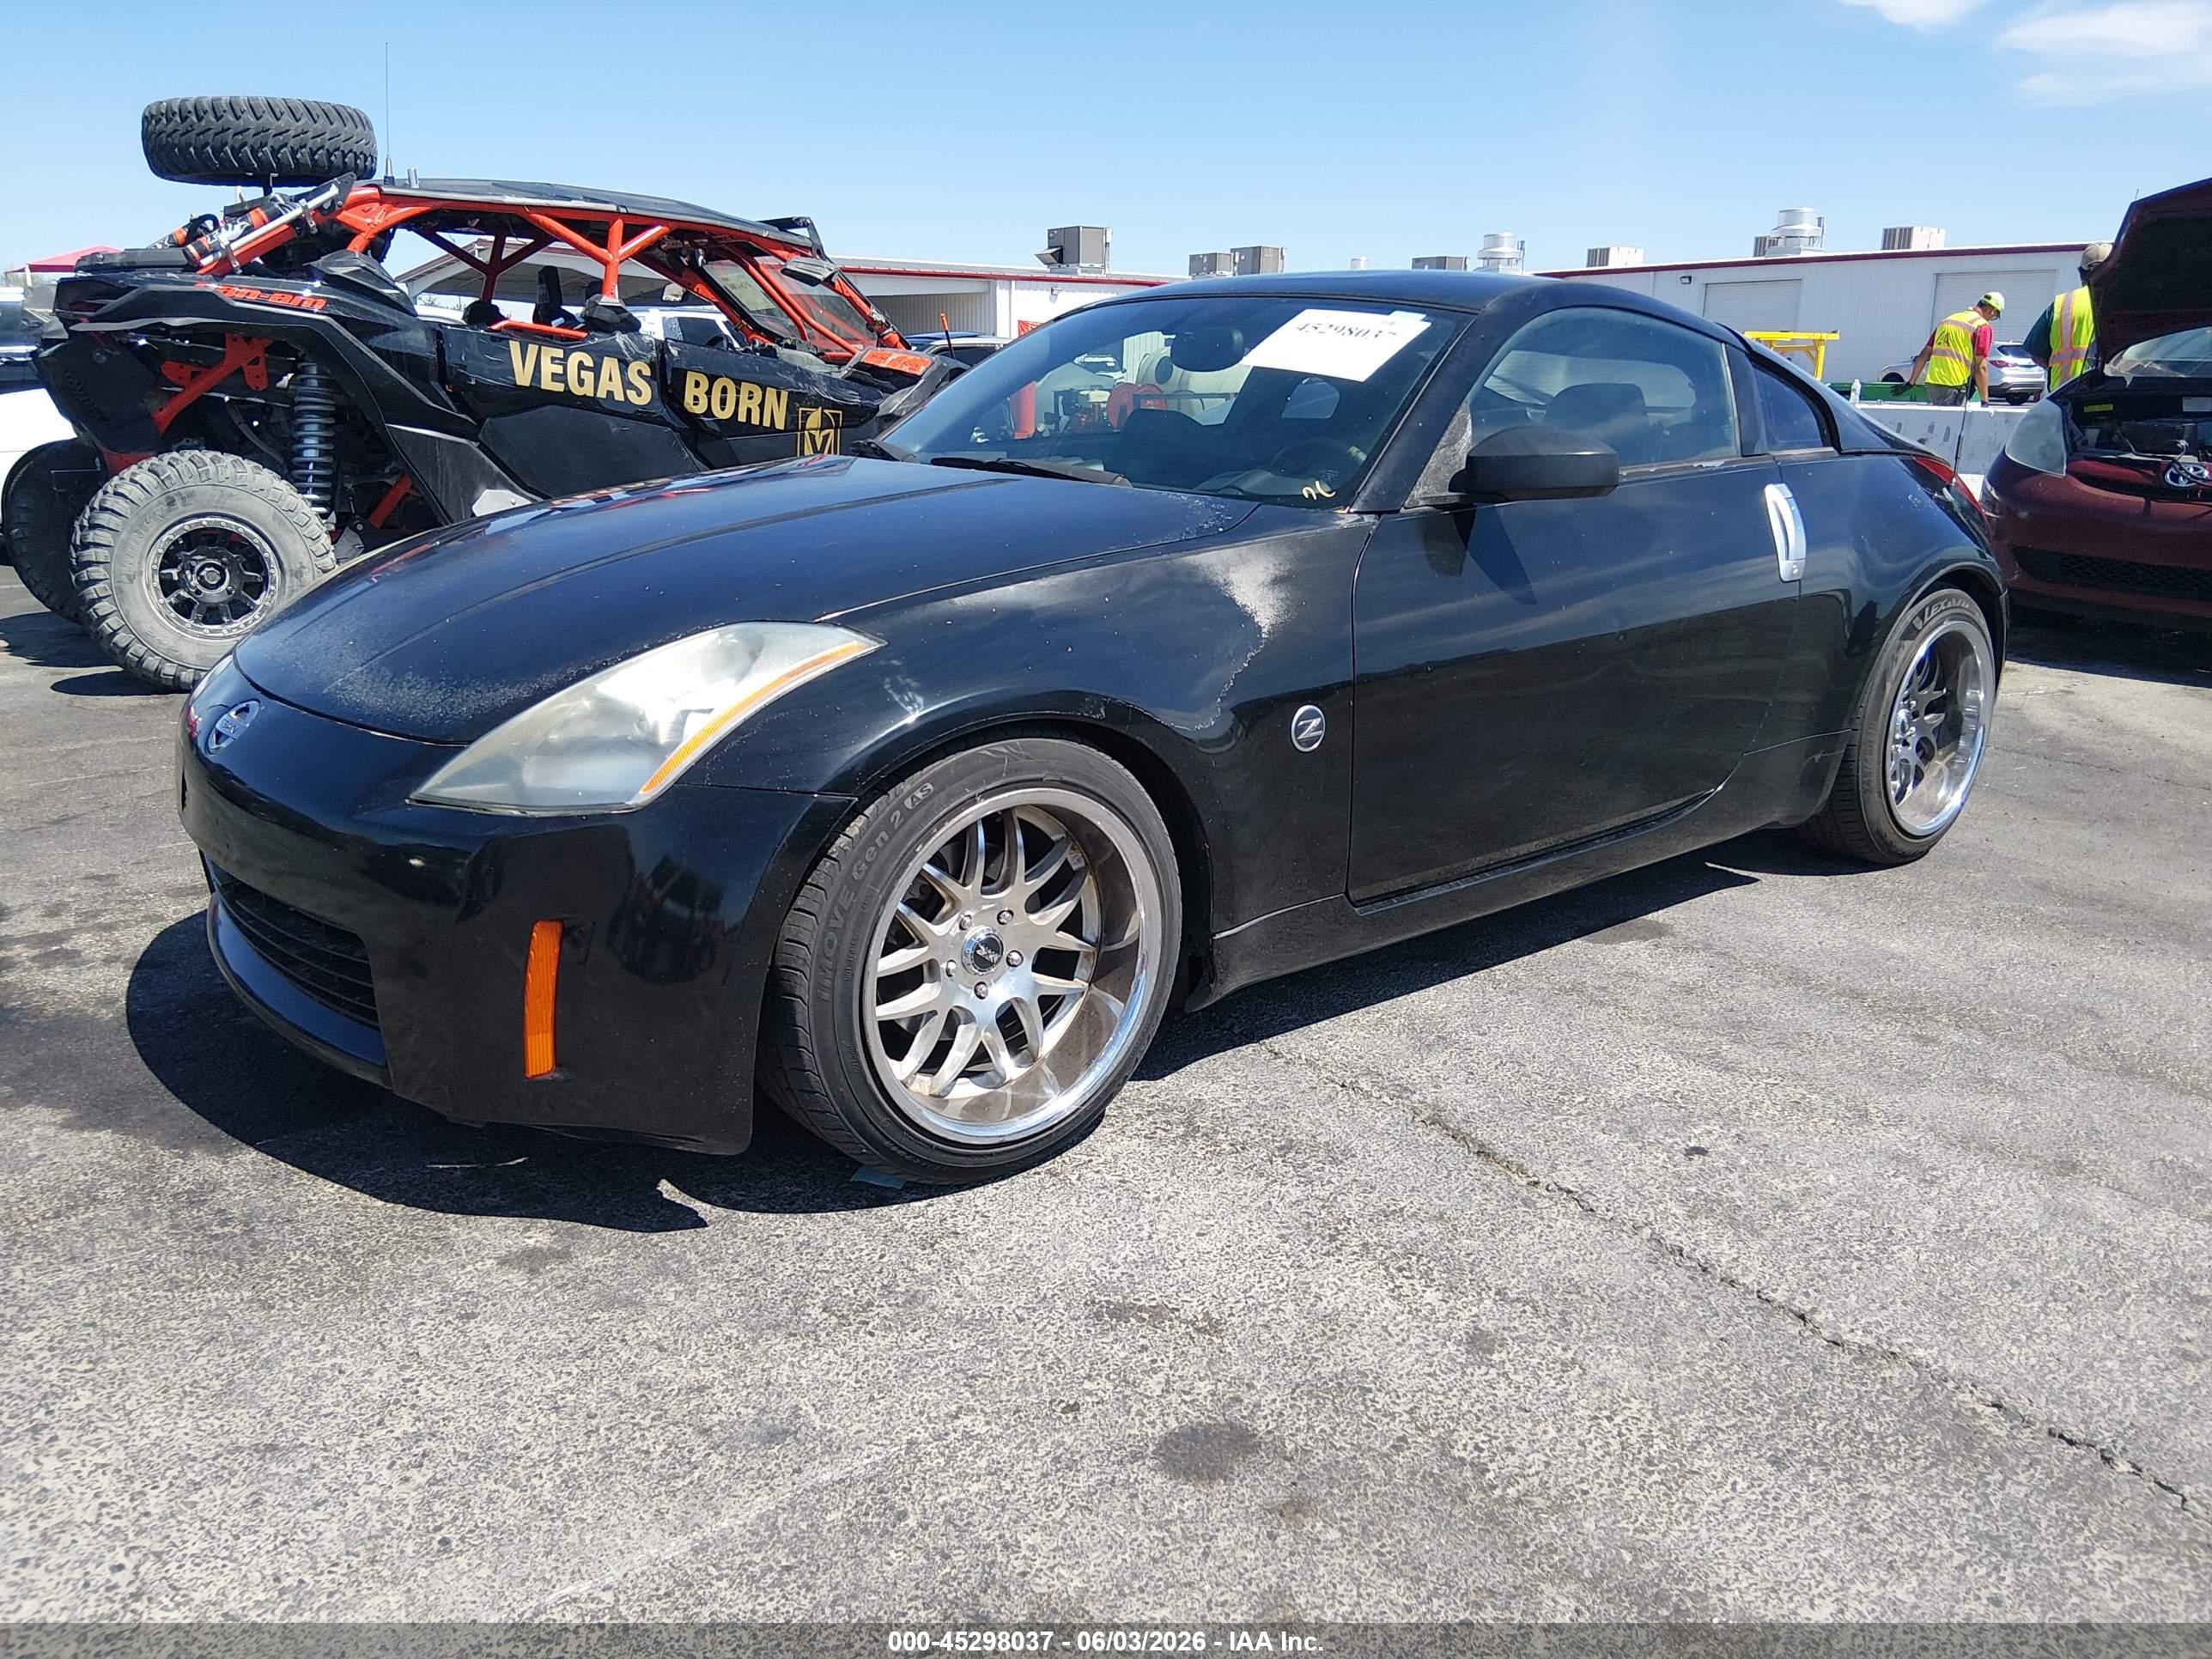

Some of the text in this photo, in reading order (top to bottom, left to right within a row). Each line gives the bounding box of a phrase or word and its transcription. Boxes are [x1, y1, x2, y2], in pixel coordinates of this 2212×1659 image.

[508, 340, 789, 430] VEGAS BORN
[1296, 716, 1323, 740] Z
[852, 830, 890, 882] Gen
[890, 809, 904, 830] 2
[906, 784, 933, 809] AS
